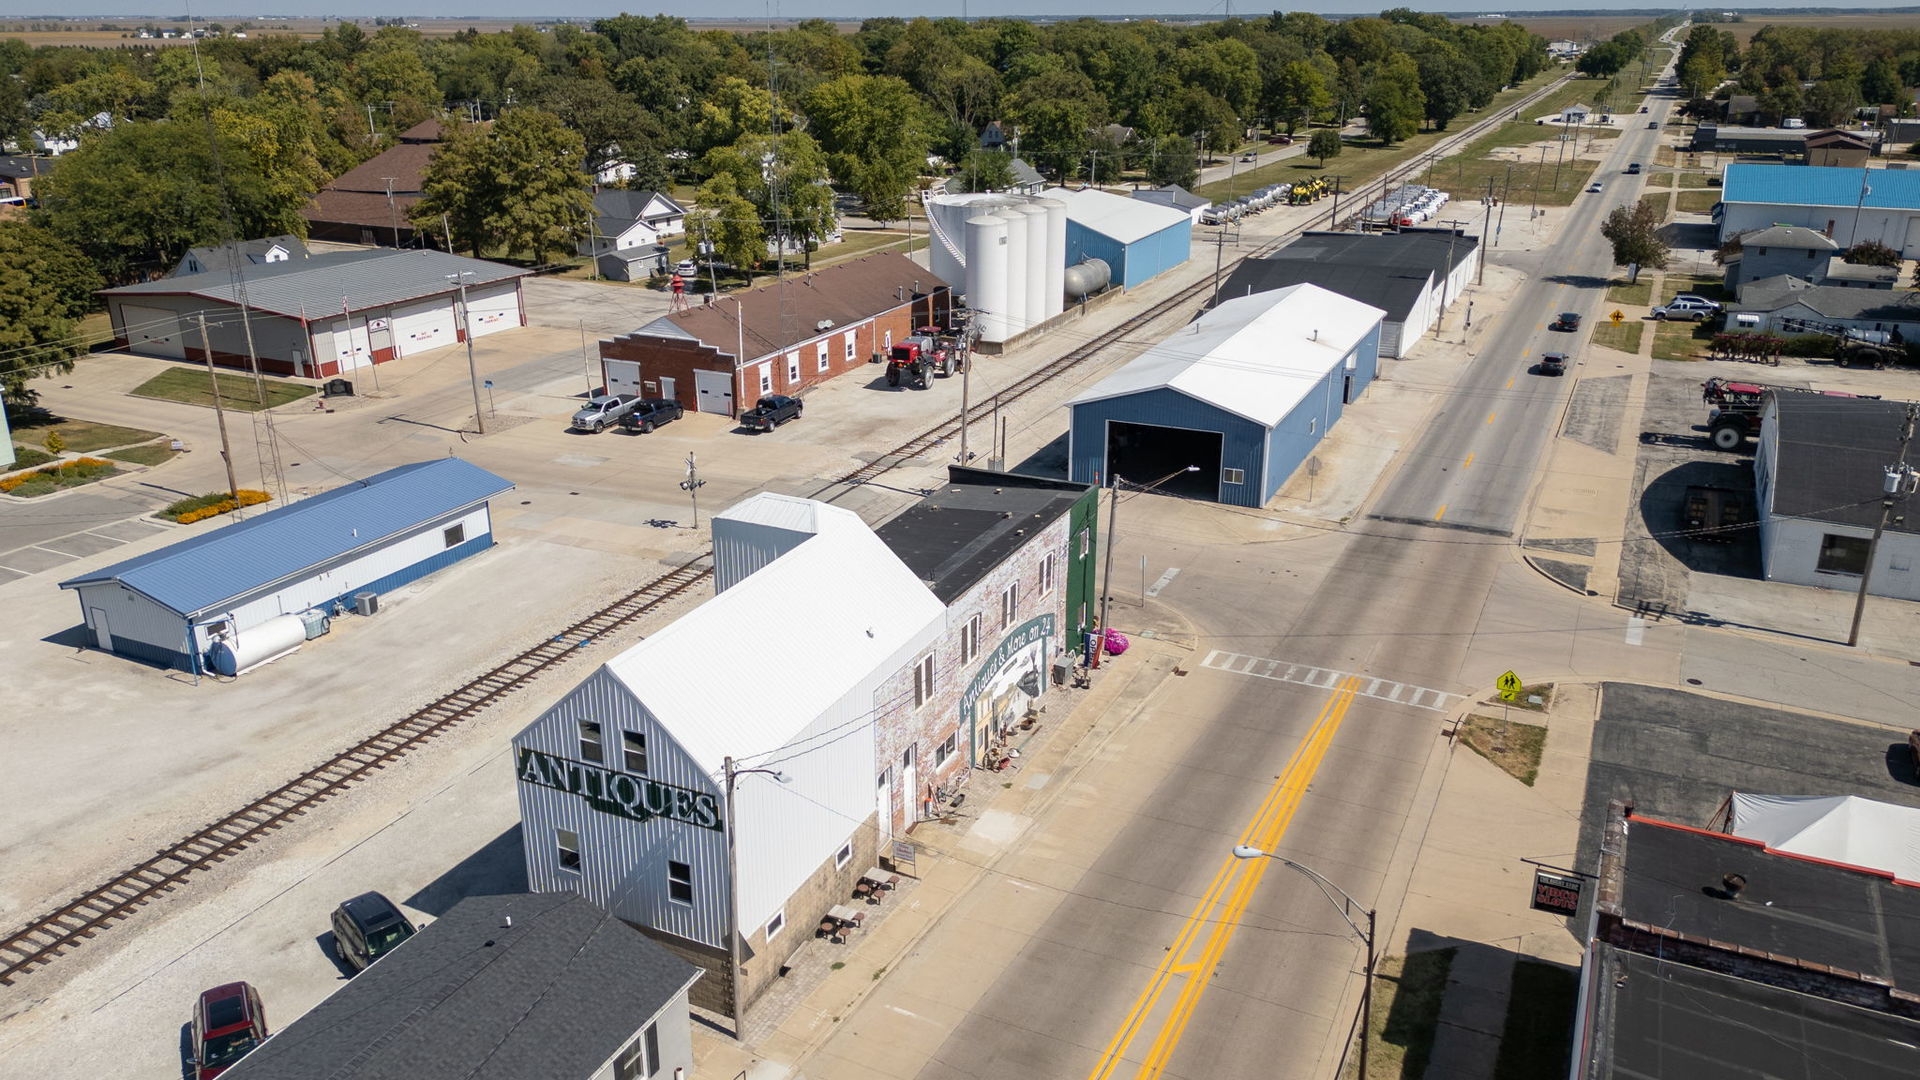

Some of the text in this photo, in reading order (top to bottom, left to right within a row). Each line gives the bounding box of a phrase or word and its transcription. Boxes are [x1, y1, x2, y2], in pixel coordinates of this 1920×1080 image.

[963, 657, 998, 715] Antiques
[998, 646, 1006, 666] &
[1007, 632, 1026, 658] More
[1028, 625, 1039, 641] on
[1040, 617, 1051, 636] 24
[522, 752, 718, 828] ANTIQUES
[1536, 894, 1577, 911] SLOTS
[1537, 884, 1578, 901] VIDEO
